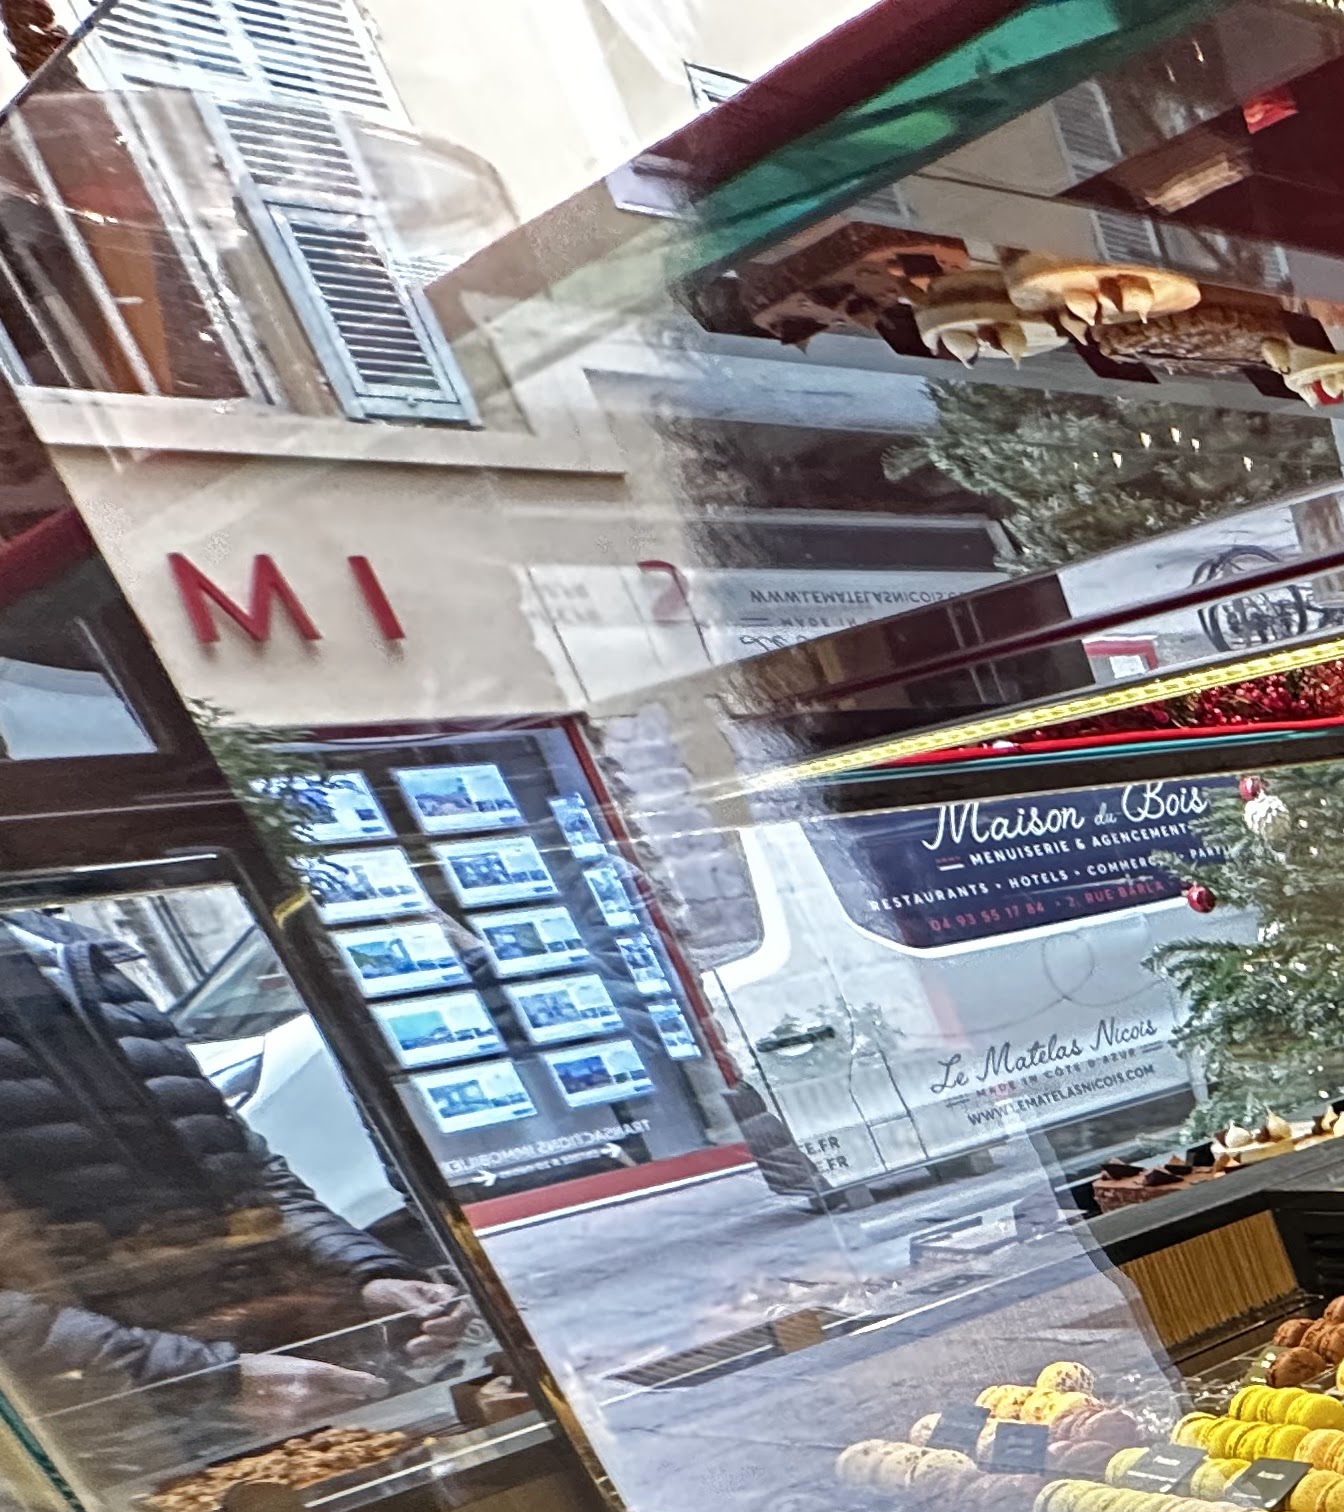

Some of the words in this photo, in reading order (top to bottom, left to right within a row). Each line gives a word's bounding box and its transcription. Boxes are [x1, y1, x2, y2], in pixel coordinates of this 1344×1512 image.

[922, 801, 1085, 851] Maison
[1094, 802, 1118, 826] du
[1121, 781, 1208, 822] Bois
[969, 839, 1071, 867] MENUISERIE
[1075, 837, 1086, 850] &
[867, 882, 990, 912] RESTAURANTS
[1007, 869, 1069, 890] HOTELS
[1084, 887, 1114, 905] RUE
[930, 1053, 970, 1095] Le
[976, 1033, 1083, 1081] Matelas
